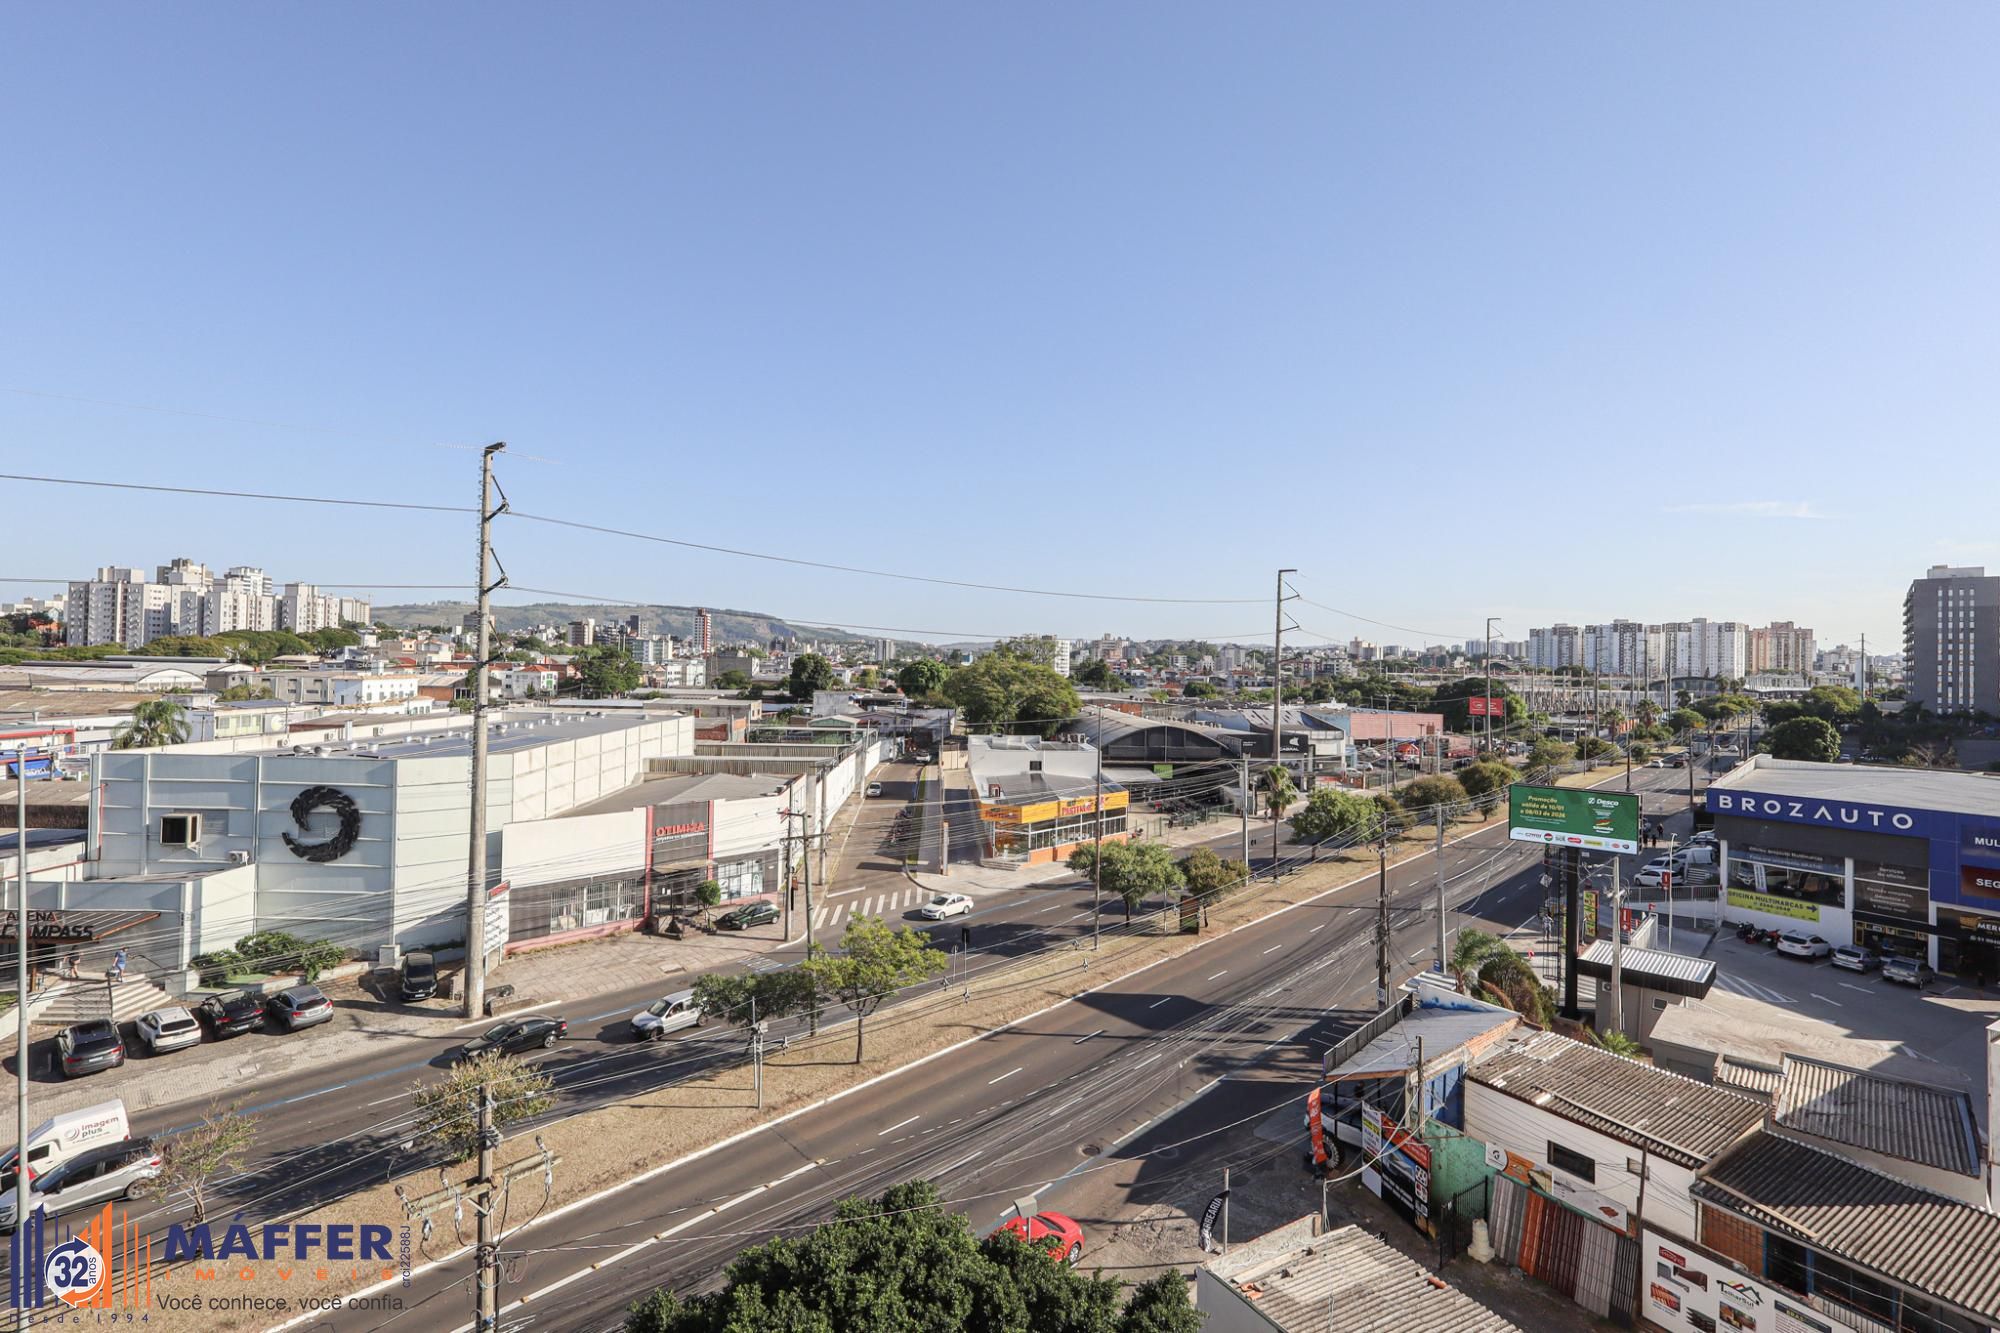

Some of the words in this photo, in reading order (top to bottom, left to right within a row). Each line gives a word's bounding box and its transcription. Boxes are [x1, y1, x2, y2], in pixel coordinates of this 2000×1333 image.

[1596, 798, 1620, 807] Desco
[1755, 896, 1804, 910] MULTIMARCAS
[6, 911, 56, 922] AENA
[2, 924, 94, 939] CMPASS
[82, 1117, 118, 1130] imagem
[82, 1128, 102, 1138] plus
